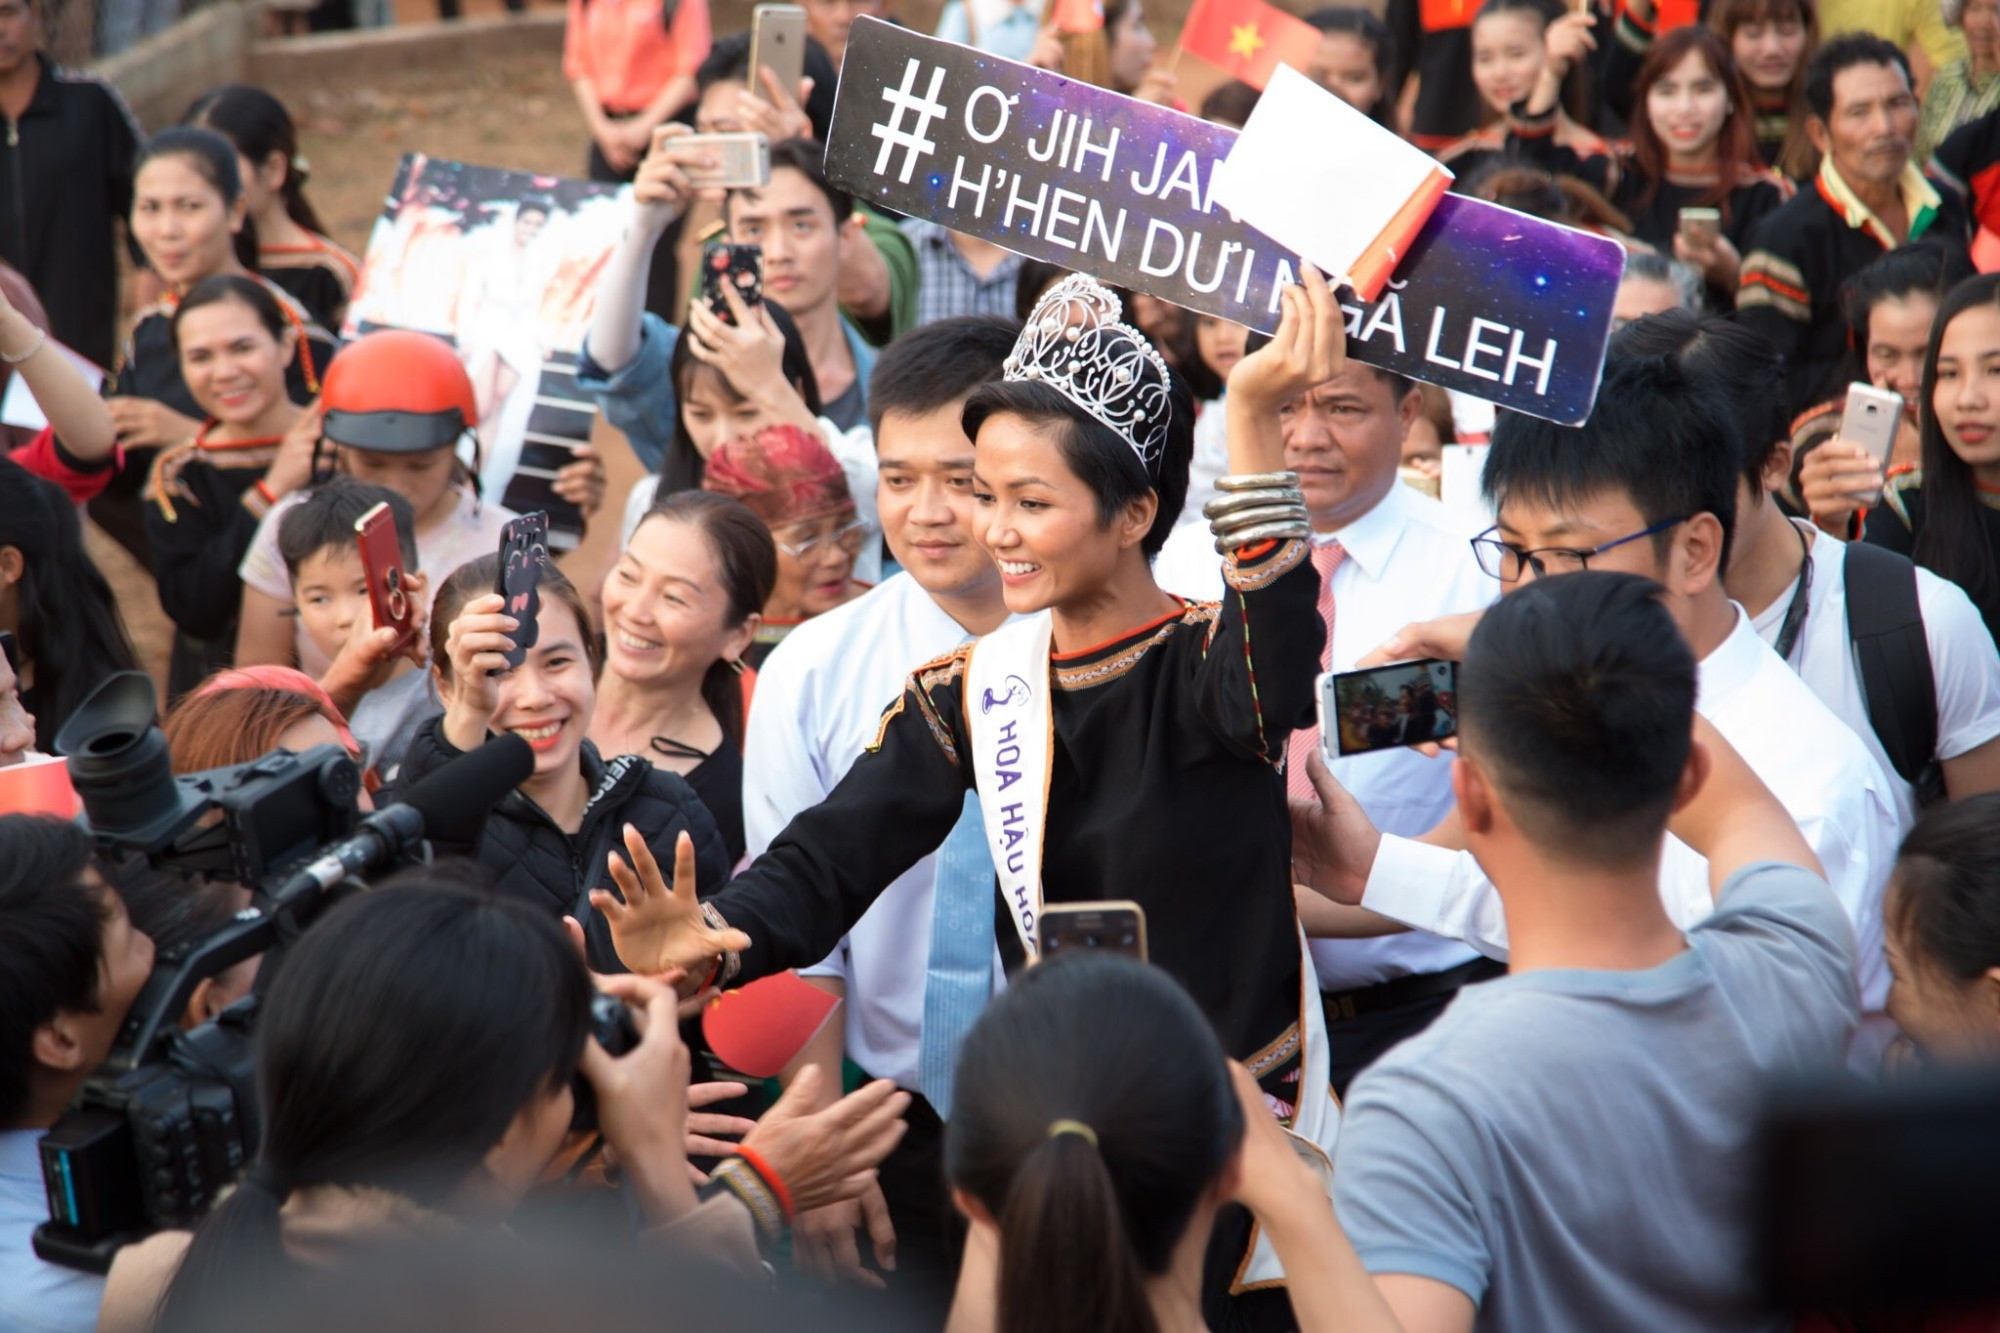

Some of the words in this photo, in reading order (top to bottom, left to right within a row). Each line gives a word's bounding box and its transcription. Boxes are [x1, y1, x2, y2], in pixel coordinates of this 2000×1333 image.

[1027, 109, 1121, 182] JIH
[947, 154, 1128, 263] H'HEN
[1138, 217, 1256, 304] DƯI
[1425, 305, 1557, 396] LEH
[995, 719, 1022, 792] HOA
[1000, 802, 1029, 874] HẬU
